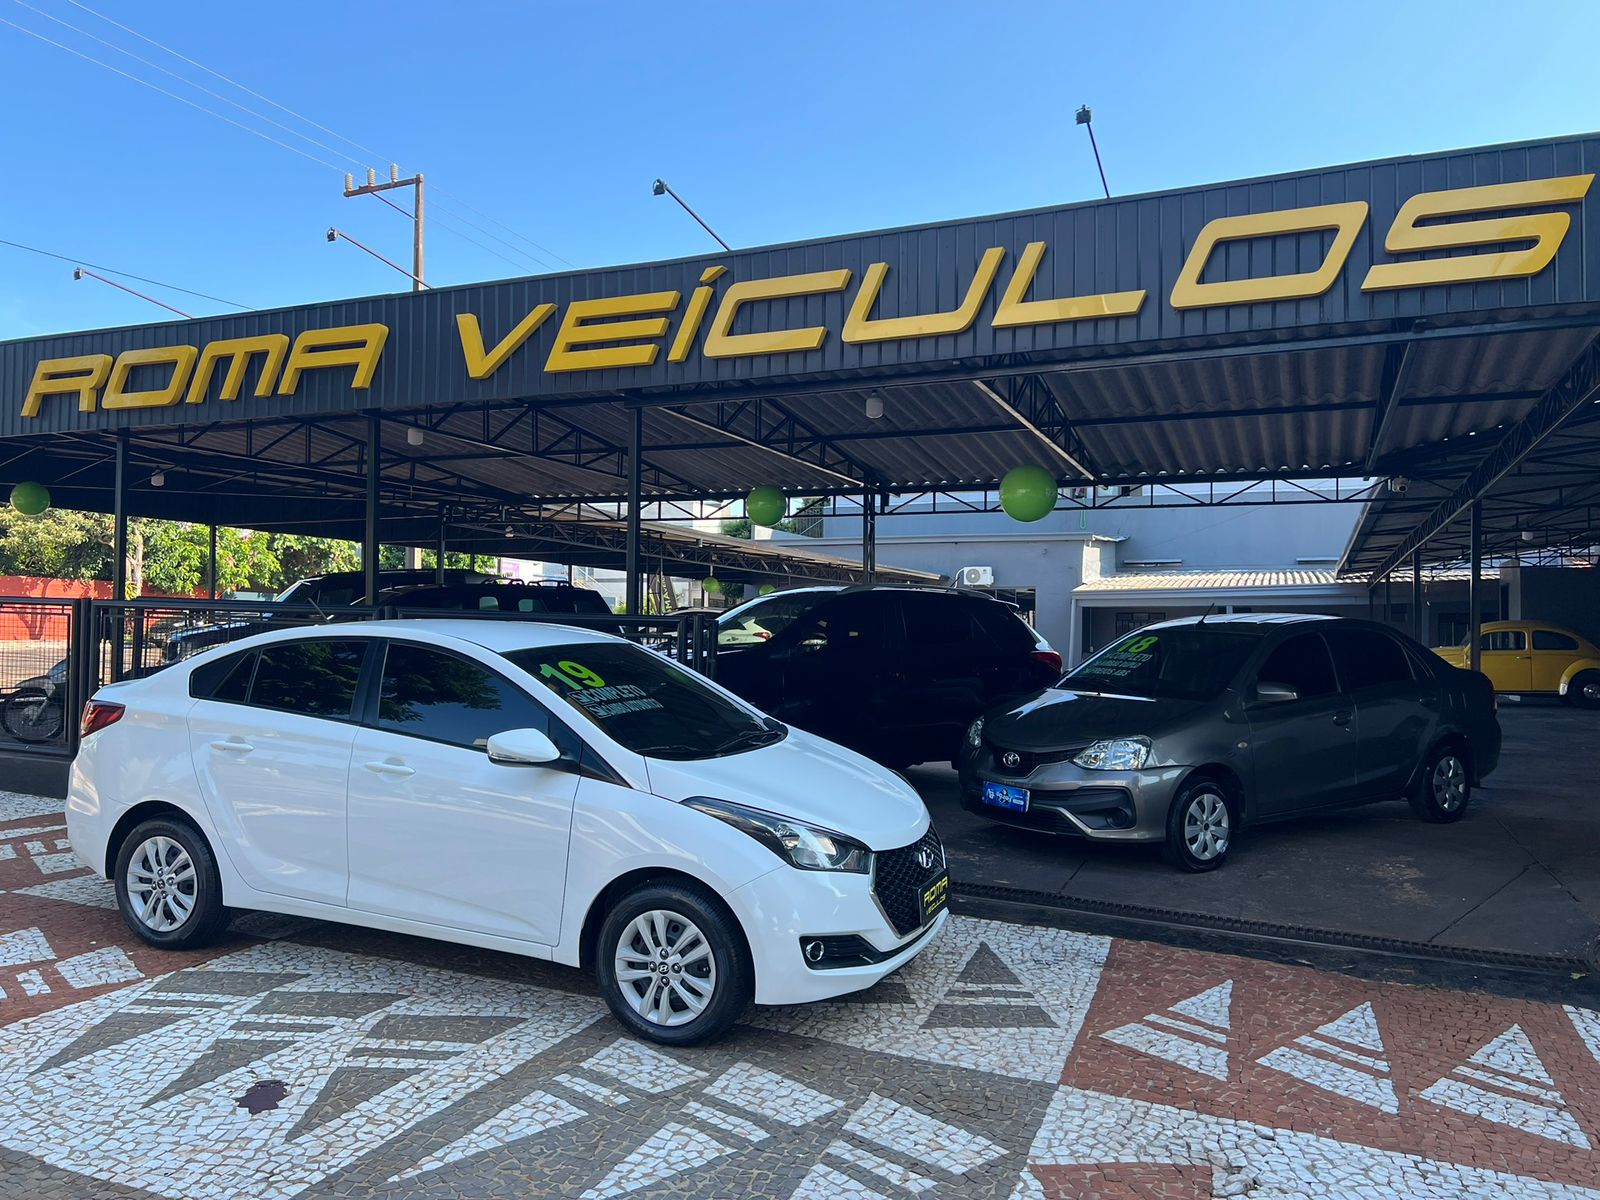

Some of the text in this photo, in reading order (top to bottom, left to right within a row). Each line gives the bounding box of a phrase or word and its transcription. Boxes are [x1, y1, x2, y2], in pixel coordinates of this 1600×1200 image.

[20, 173, 1595, 418] ROMA VEÍCULOS
[1117, 636, 1158, 653] 18
[540, 661, 605, 690] 19
[580, 684, 647, 702] COMPLETO
[924, 876, 948, 907] ROMA
